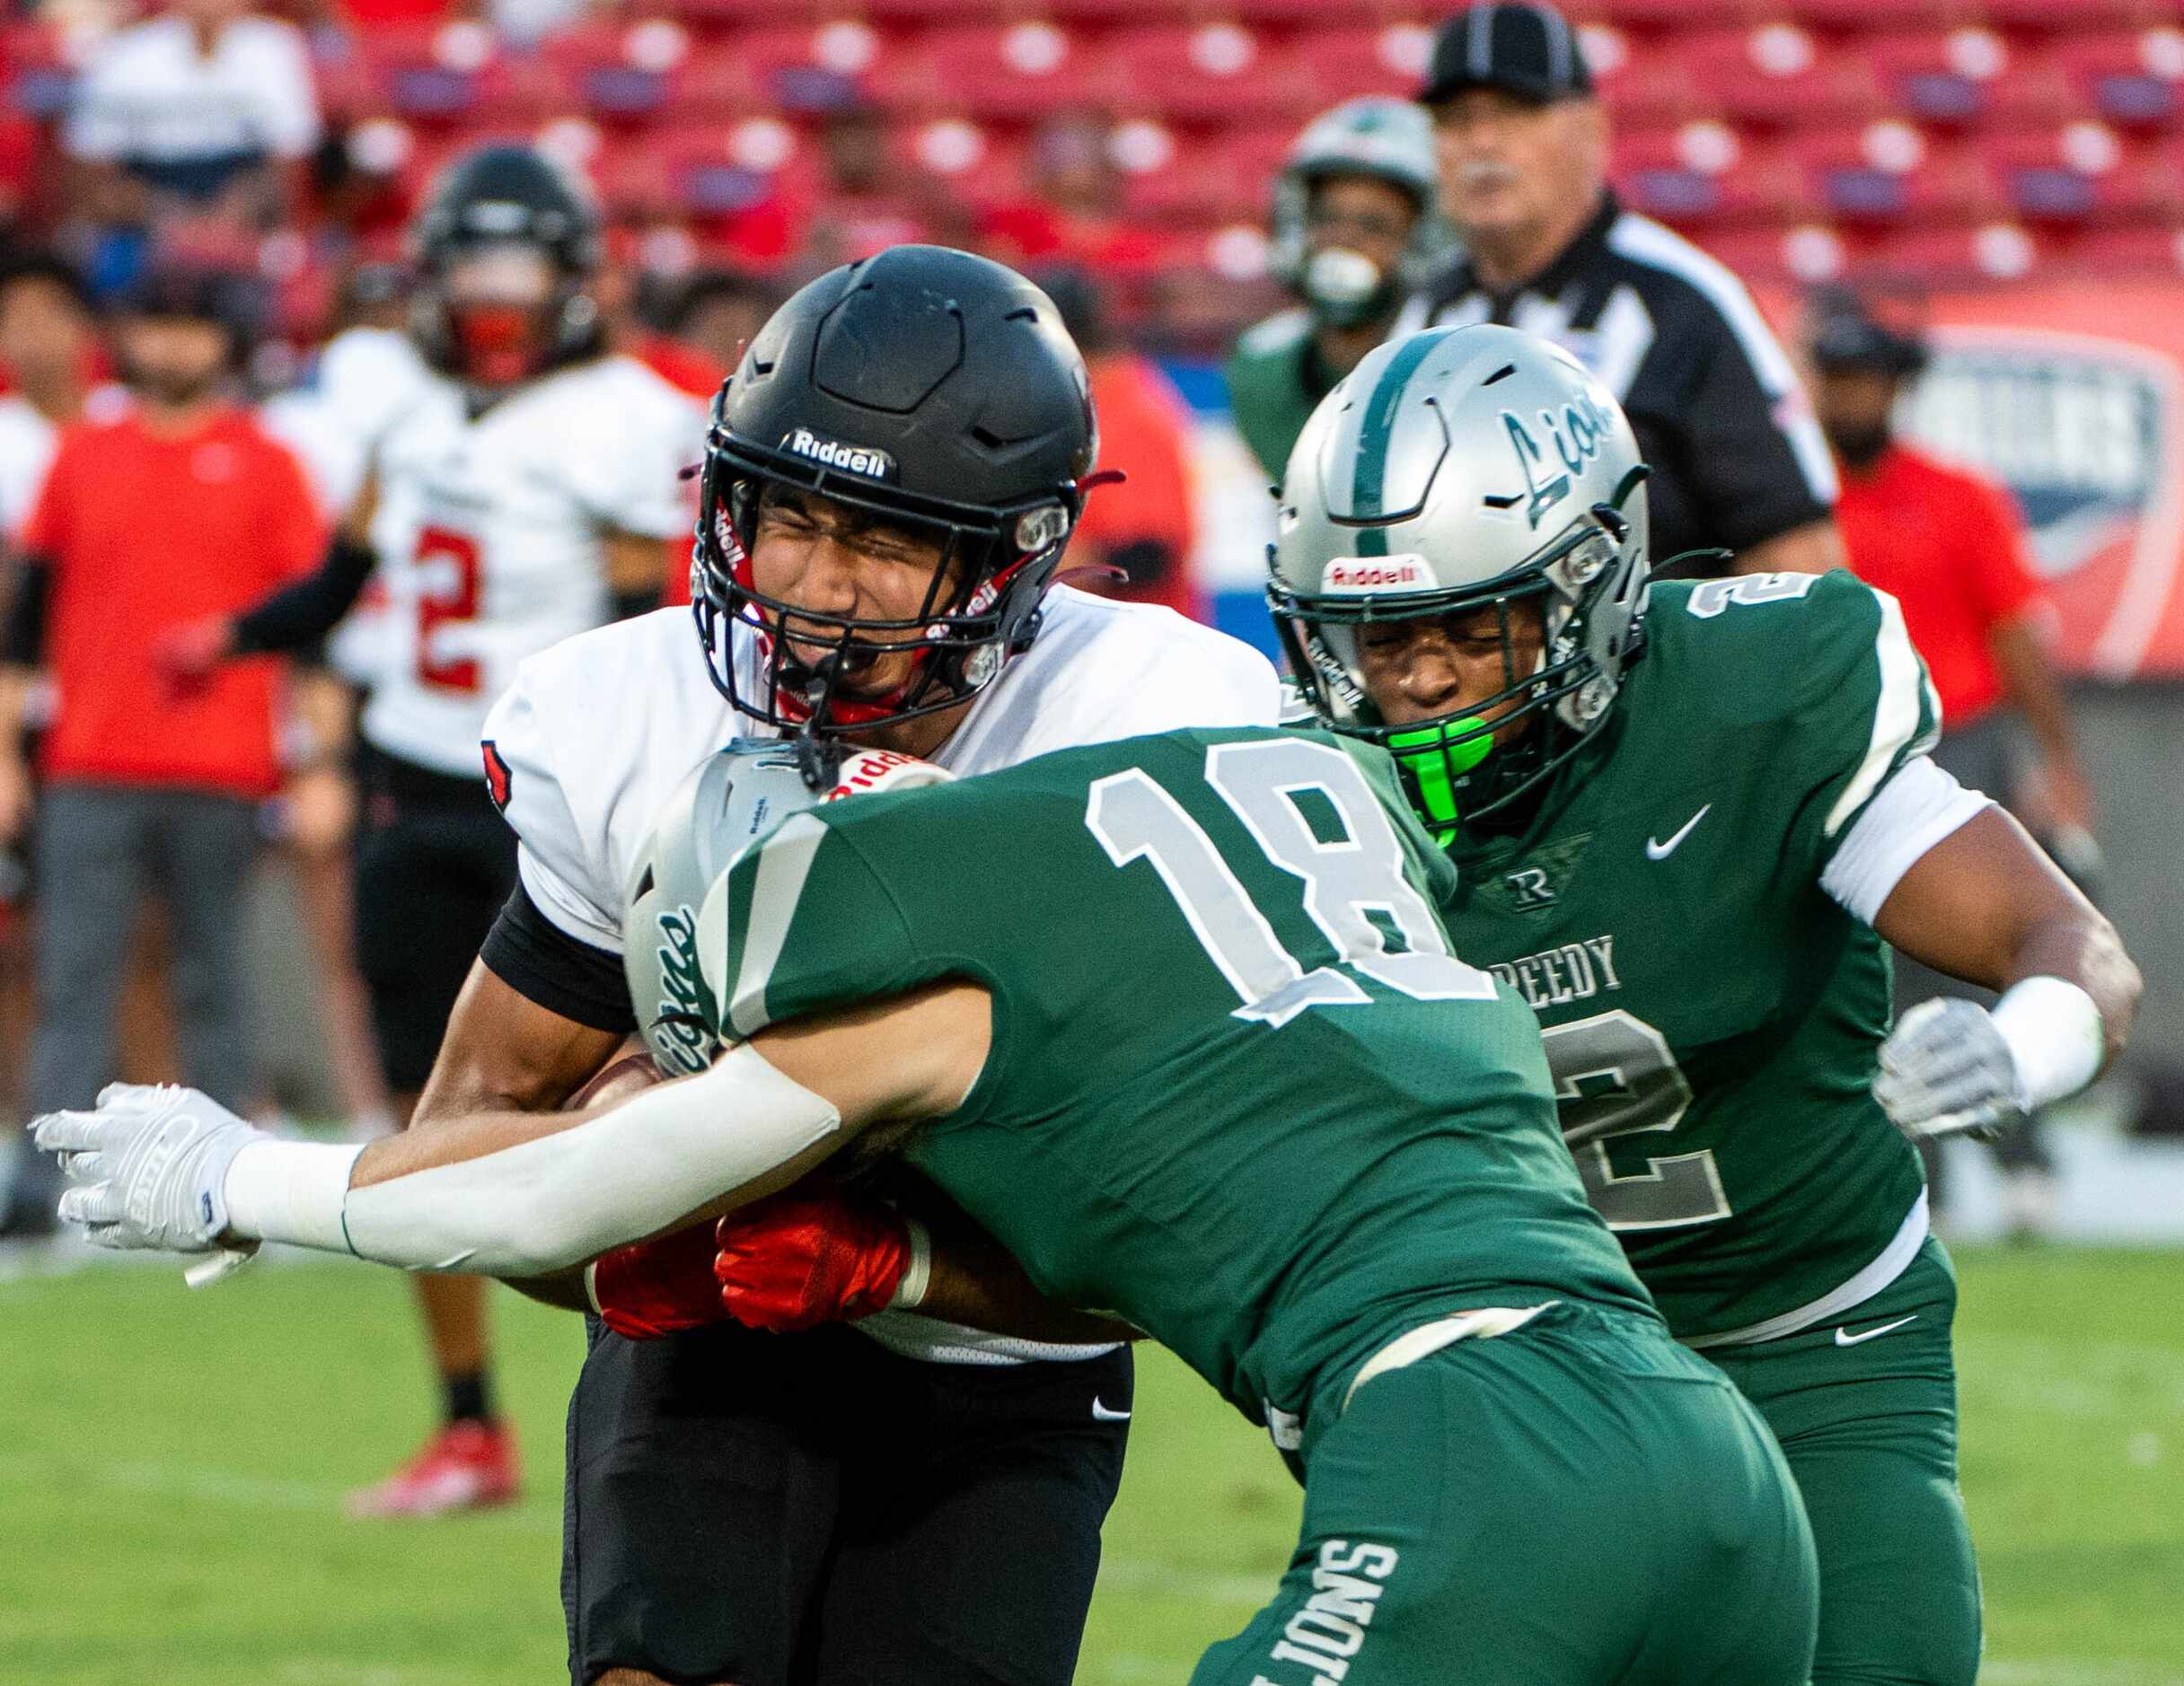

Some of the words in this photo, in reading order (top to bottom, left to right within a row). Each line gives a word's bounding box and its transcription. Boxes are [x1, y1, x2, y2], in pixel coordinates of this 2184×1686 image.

[791, 427, 885, 479] Riddell
[412, 523, 486, 697] 2
[1332, 566, 1415, 585] Riddell
[1686, 571, 1824, 619] 2
[1085, 736, 1500, 1030] 18
[1506, 866, 1556, 907] R
[656, 902, 712, 1073] ions
[1538, 1008, 1732, 1231] 2
[1250, 1539, 1400, 1686] IONS
